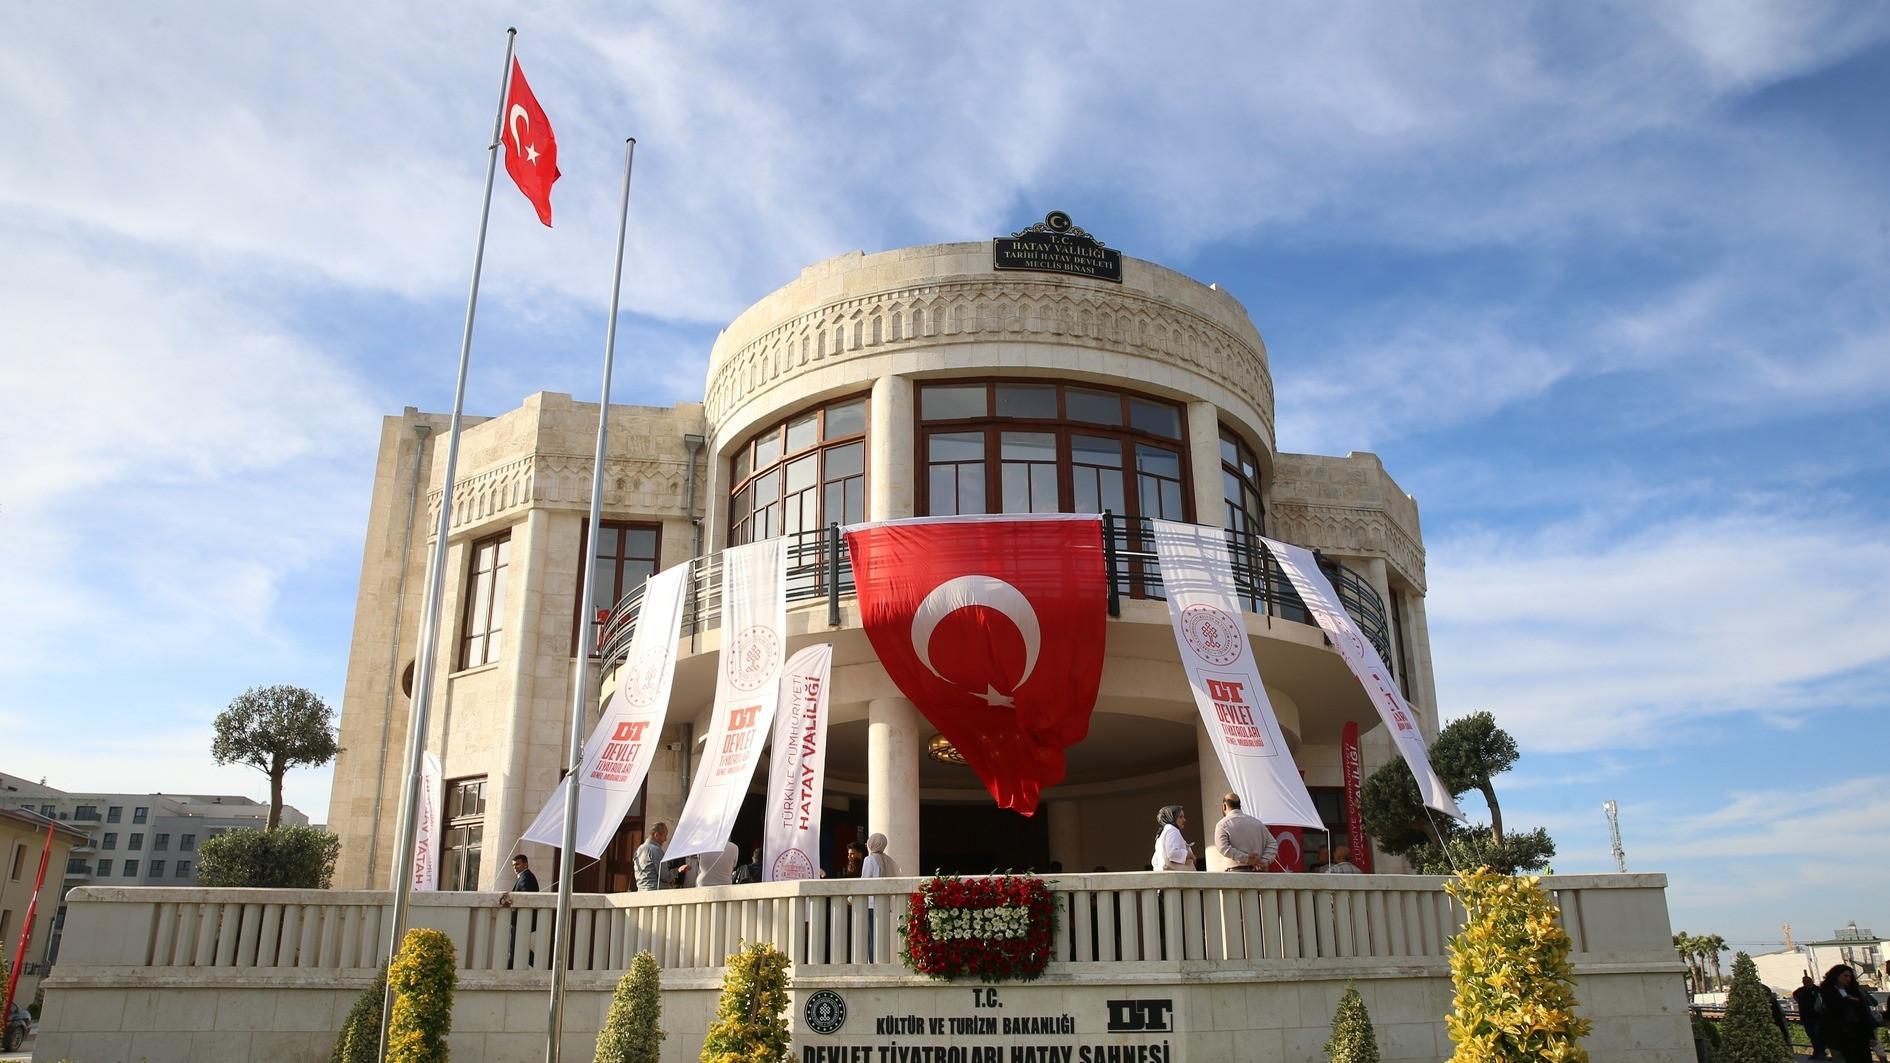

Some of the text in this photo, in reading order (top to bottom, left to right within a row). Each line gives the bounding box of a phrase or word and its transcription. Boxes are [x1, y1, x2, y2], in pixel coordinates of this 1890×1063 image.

[1004, 251, 1038, 259] TARİHİ
[1041, 253, 1073, 262] HATAY
[1012, 242, 1105, 259] HATAY VALİLİĞİ
[1025, 260, 1095, 274] MECLİS BİNASI
[1205, 678, 1244, 703] DT
[728, 705, 762, 731] DT
[1214, 703, 1254, 725] DEVLET
[612, 721, 650, 741] DT
[722, 729, 756, 754] DEVLET
[601, 743, 642, 762] DEVLET
[782, 674, 802, 828] TÜRKİYE CUMHURİYETİ
[799, 676, 820, 830] HATAY VALİLİĞİ
[972, 988, 1003, 1008] T.C.
[876, 1013, 1075, 1035] KÜLTÜR VE TURİZM BAKANLIĞI
[1107, 999, 1173, 1033] DT
[803, 1040, 1170, 1063] DEVLET TİYATROLARI HATAY SAHNESİ
